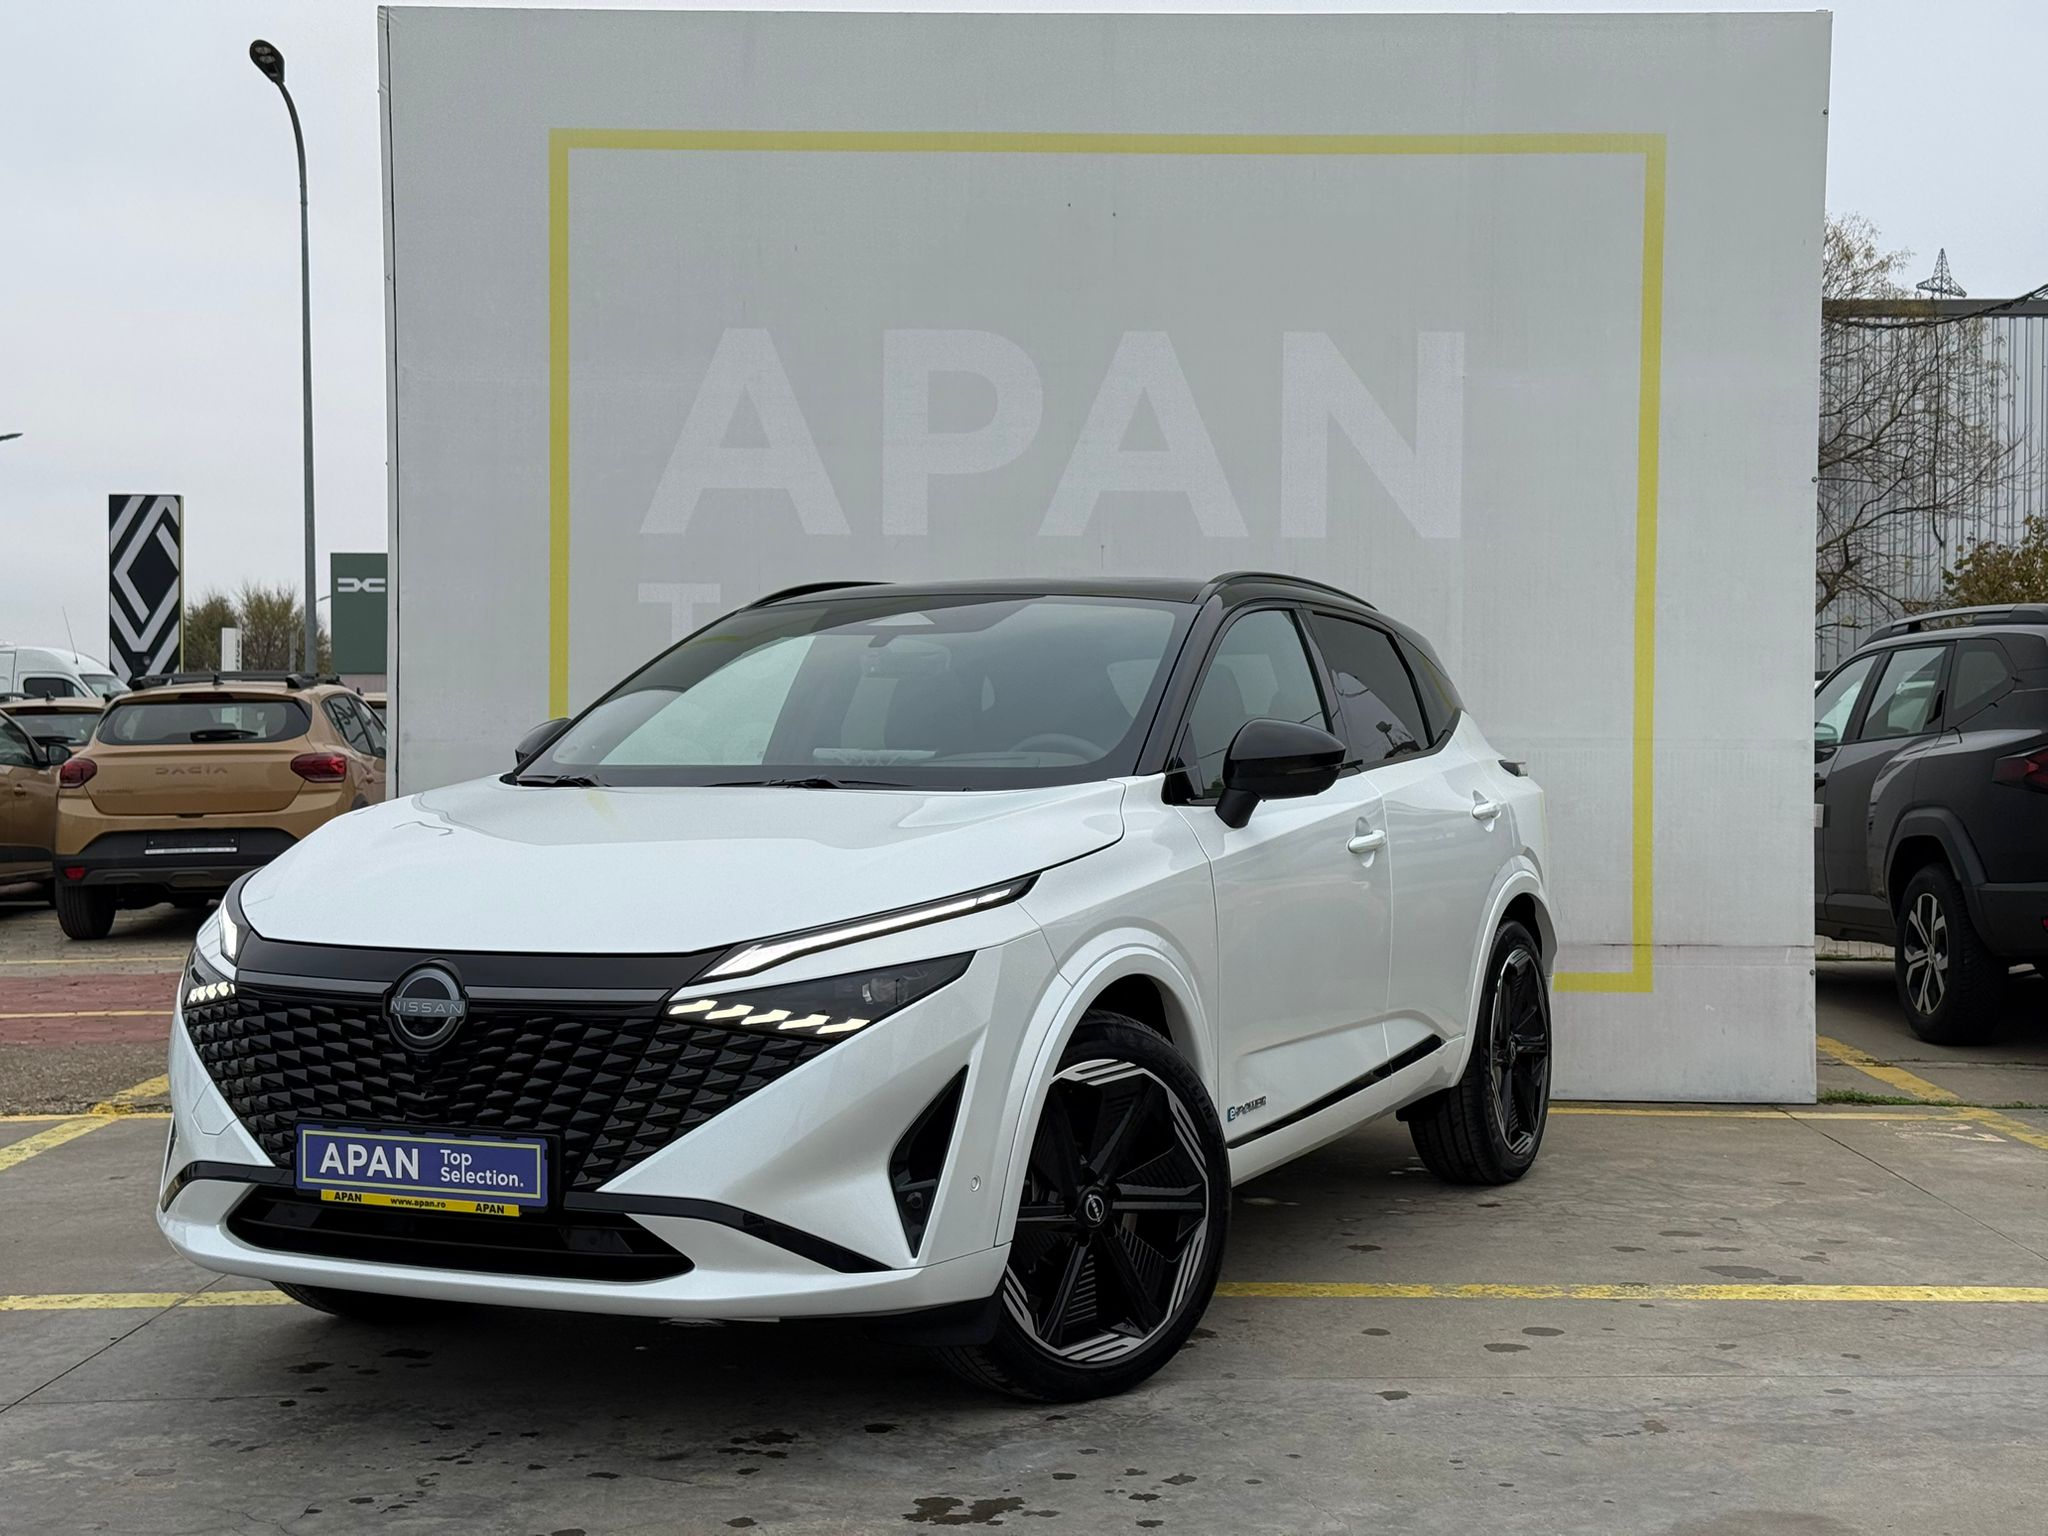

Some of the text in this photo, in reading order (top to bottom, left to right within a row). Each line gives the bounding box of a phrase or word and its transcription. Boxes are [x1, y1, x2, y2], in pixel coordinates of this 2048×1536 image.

[640, 327, 1465, 539] APAN
[391, 1001, 462, 1014] NISSAN
[319, 1142, 473, 1181] APAN Top
[440, 1167, 525, 1187] Selection.
[334, 1191, 505, 1215] APAN www.apan.ro APAN
